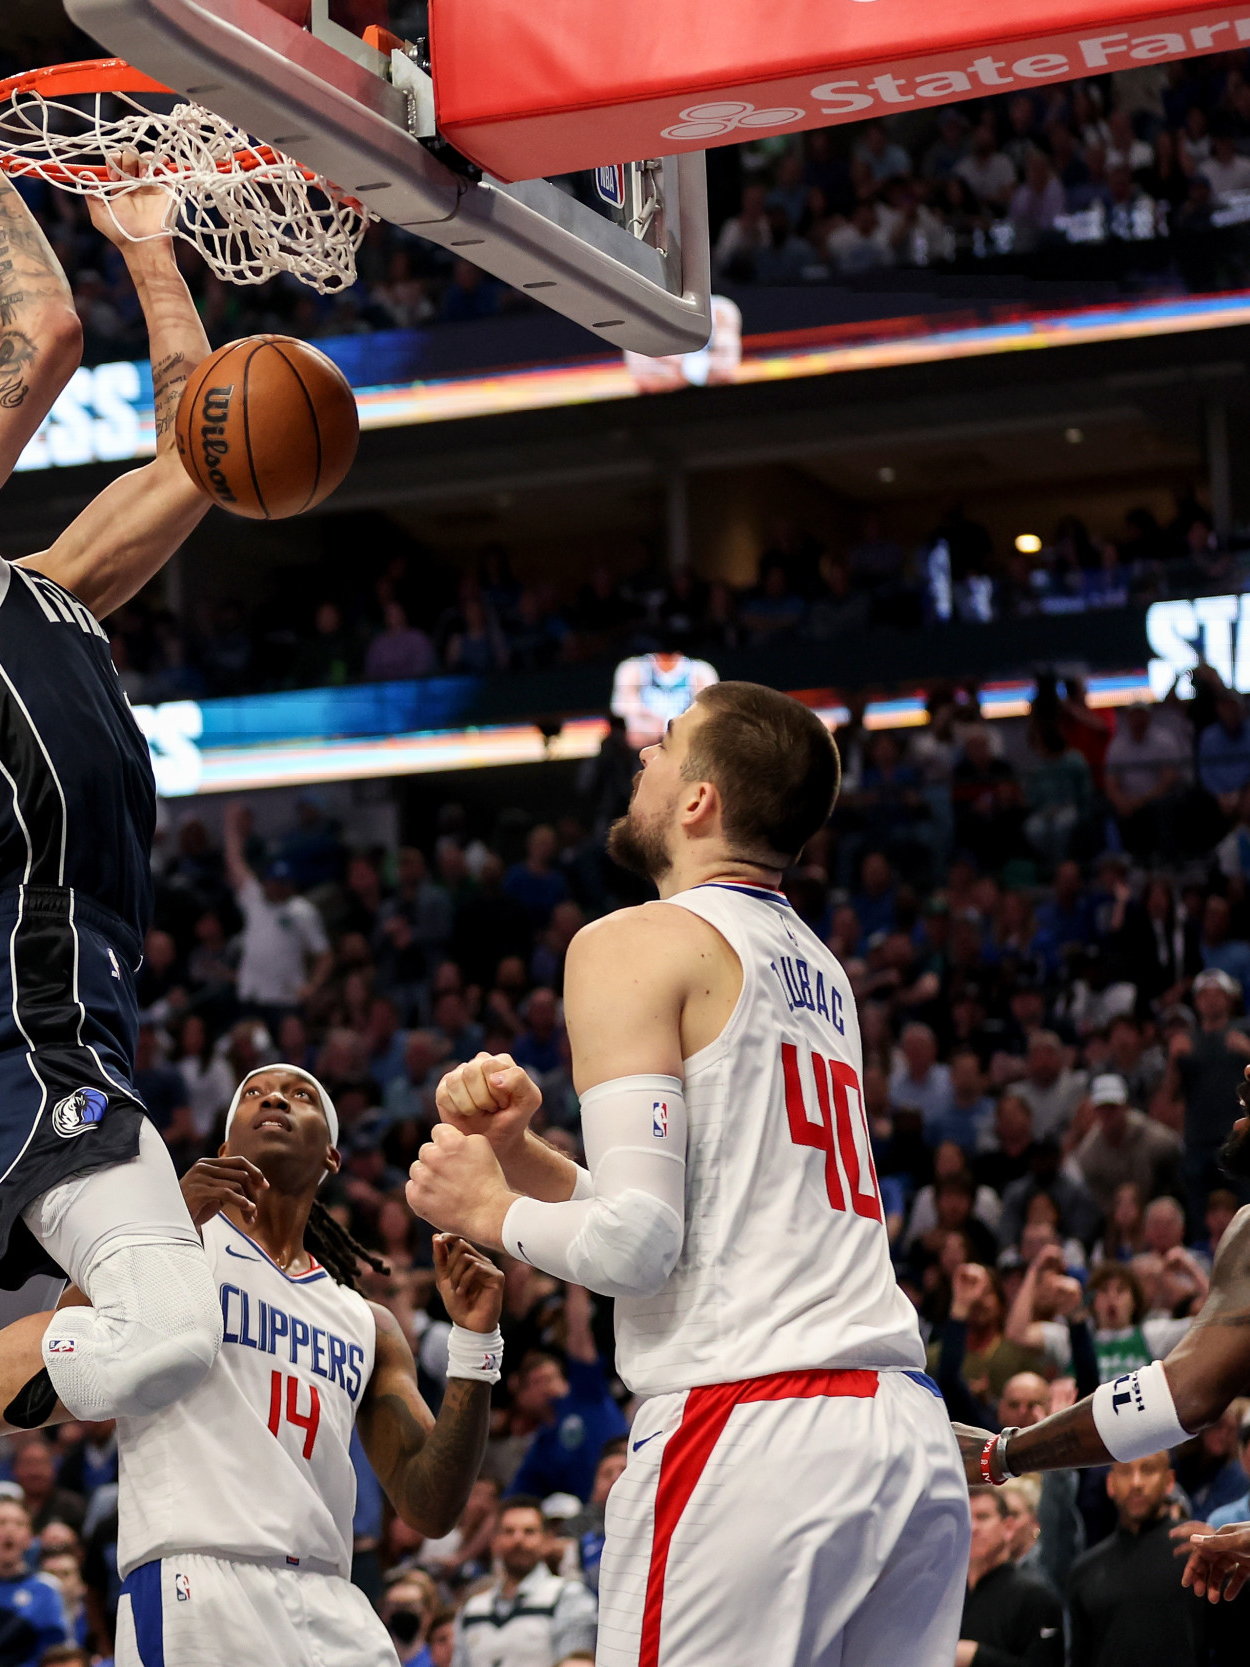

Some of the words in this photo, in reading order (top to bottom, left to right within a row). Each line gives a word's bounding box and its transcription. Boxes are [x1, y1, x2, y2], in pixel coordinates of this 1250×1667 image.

[810, 53, 1070, 115] State
[201, 384, 239, 503] Wilson
[781, 1042, 883, 1225] 40
[220, 1282, 364, 1402] CLIPPERS
[268, 1369, 321, 1461] 14
